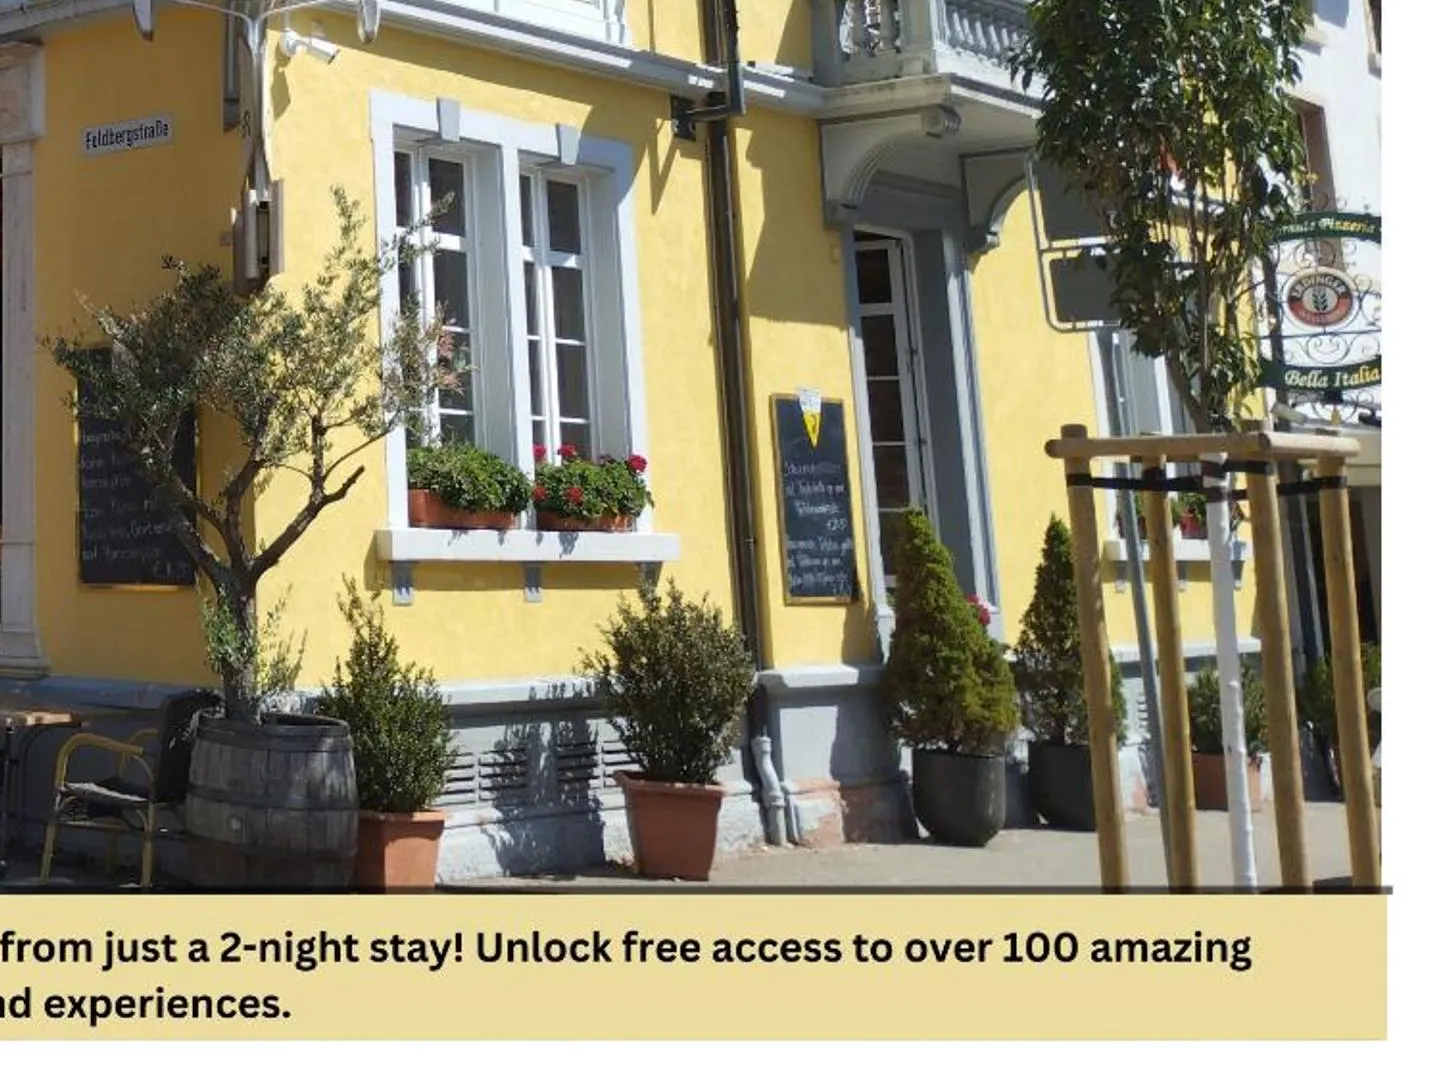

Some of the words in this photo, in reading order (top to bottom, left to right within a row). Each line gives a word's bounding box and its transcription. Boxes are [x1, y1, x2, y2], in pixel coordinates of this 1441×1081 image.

[86, 119, 169, 151] Feldbergstraße
[1285, 370, 1329, 388] Bella
[1334, 365, 1380, 387] Italia
